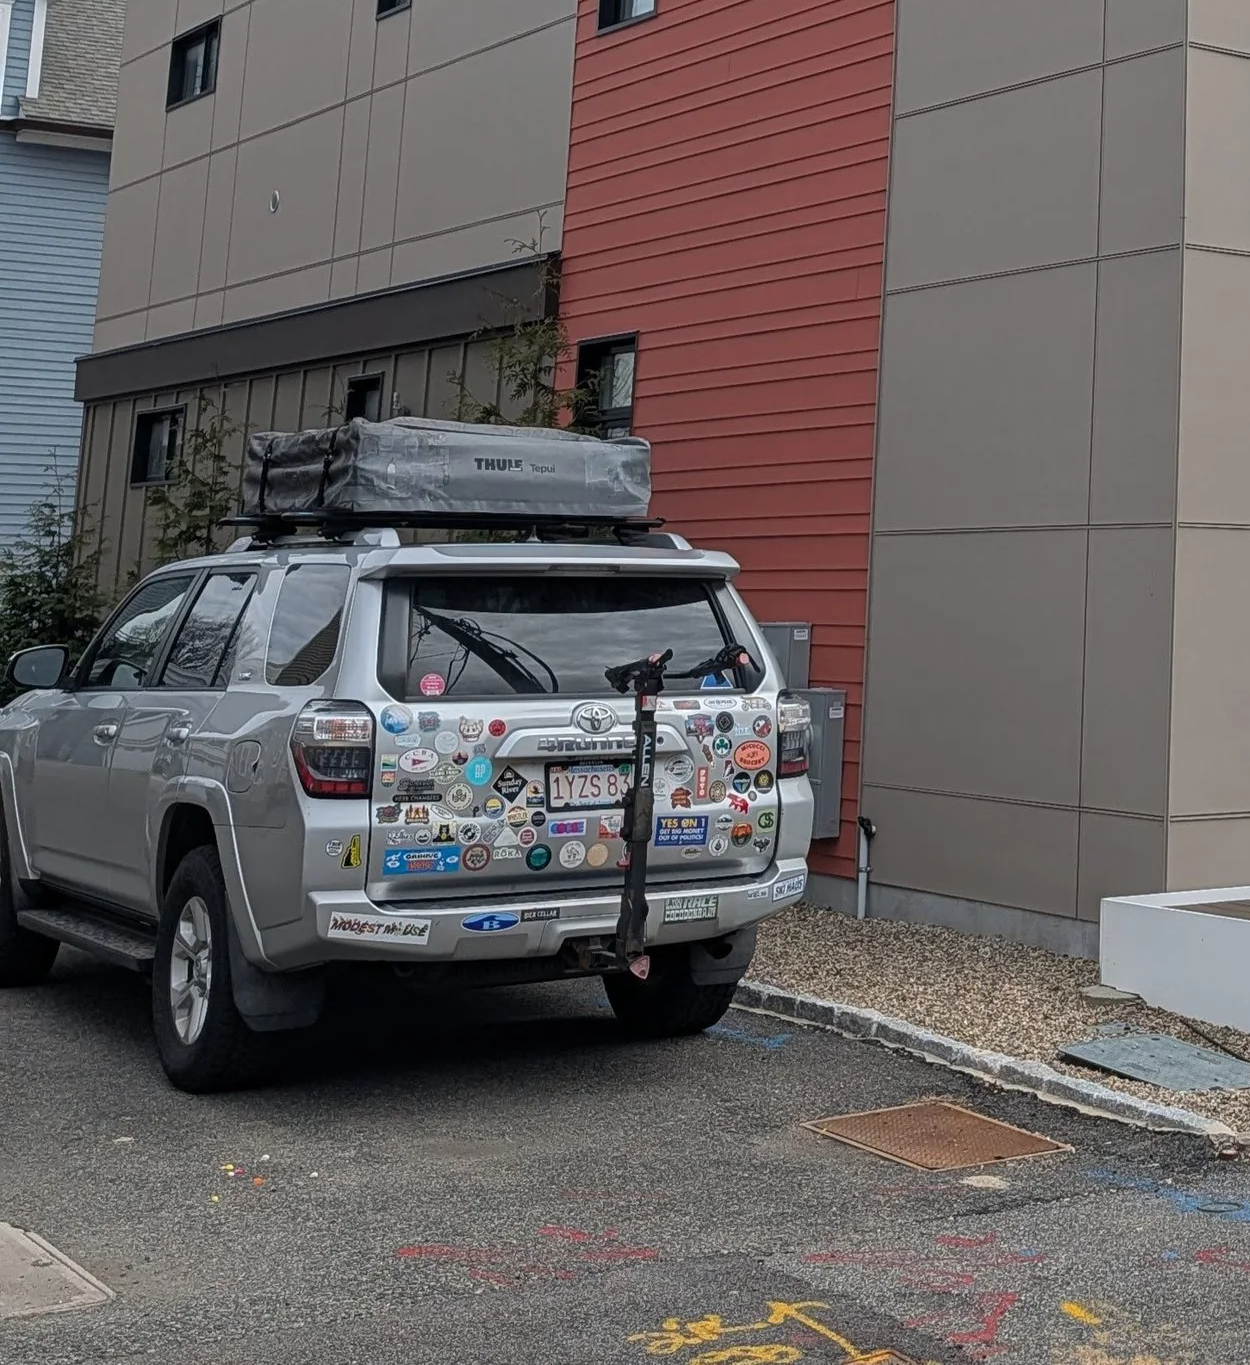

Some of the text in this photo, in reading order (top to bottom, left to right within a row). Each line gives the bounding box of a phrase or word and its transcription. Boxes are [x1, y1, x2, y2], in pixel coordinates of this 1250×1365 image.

[474, 458, 556, 474] THULE Tepui
[640, 734, 652, 787] ALLEN
[498, 779, 522, 788] Sunday
[502, 786, 520, 794] River
[553, 775, 601, 800] 1YZS
[661, 818, 678, 828] YES
[701, 818, 705, 827] 1
[330, 916, 384, 935] MODEST
